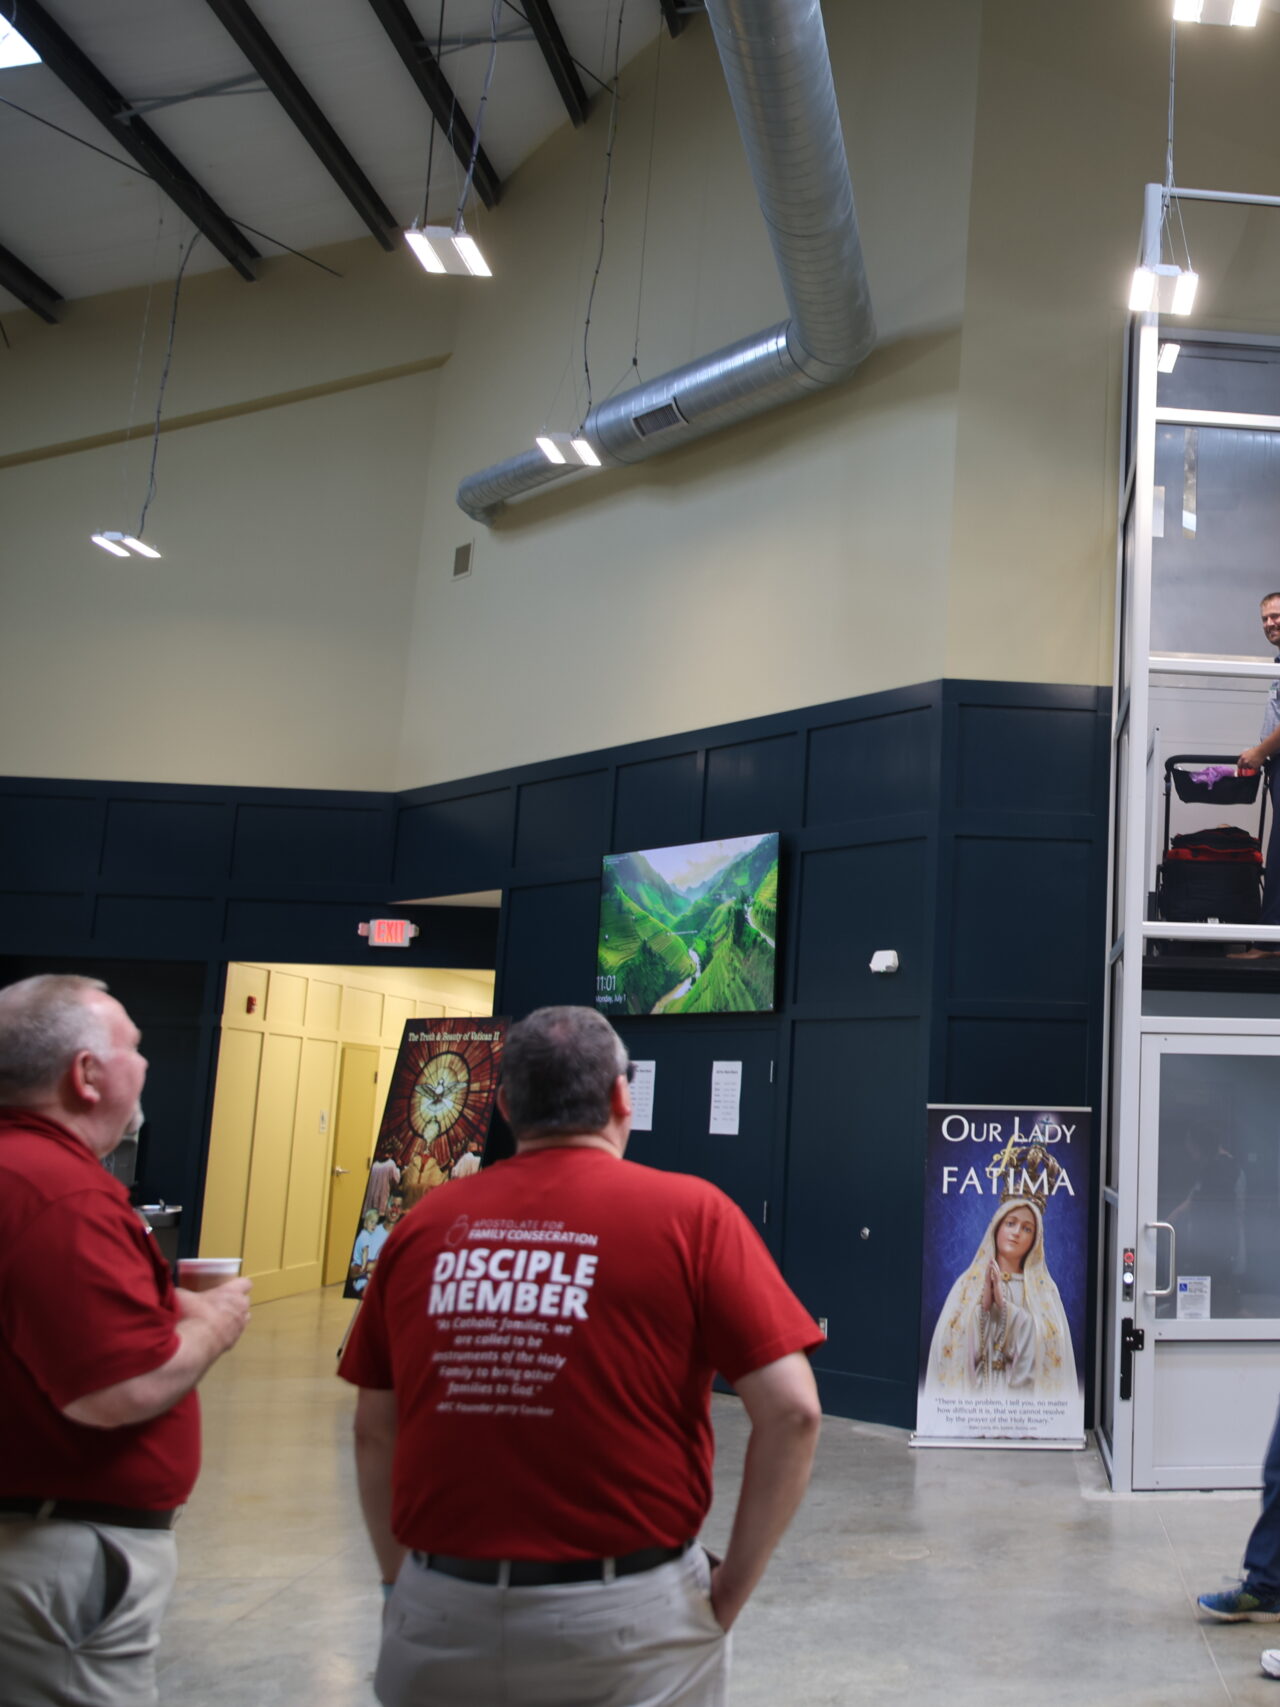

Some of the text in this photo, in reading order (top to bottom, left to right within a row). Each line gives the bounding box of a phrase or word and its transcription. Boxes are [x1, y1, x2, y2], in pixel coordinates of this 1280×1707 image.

[374, 920, 407, 943] EXIT
[596, 975, 616, 991] 11:01
[409, 1032, 419, 1042] The
[420, 1032, 435, 1042] Truth
[442, 1032, 462, 1042] Beauty
[471, 1031, 492, 1041] Vatican
[942, 1166, 1075, 1196] FATIMA
[472, 1218, 565, 1230] APOSTOLATE FOR
[468, 1229, 599, 1246] FAMILY CONSECRATION
[433, 1247, 599, 1287] DISCIPLE
[428, 1279, 589, 1321] MEMBER
[452, 1317, 498, 1330] Catholic
[499, 1317, 550, 1332] families,
[554, 1324, 573, 1335] we
[454, 1333, 543, 1348] are called to be
[432, 1351, 567, 1369] instruments of the Holy
[438, 1365, 556, 1381] Family to bring other
[447, 1381, 492, 1396] families
[495, 1383, 508, 1394] to
